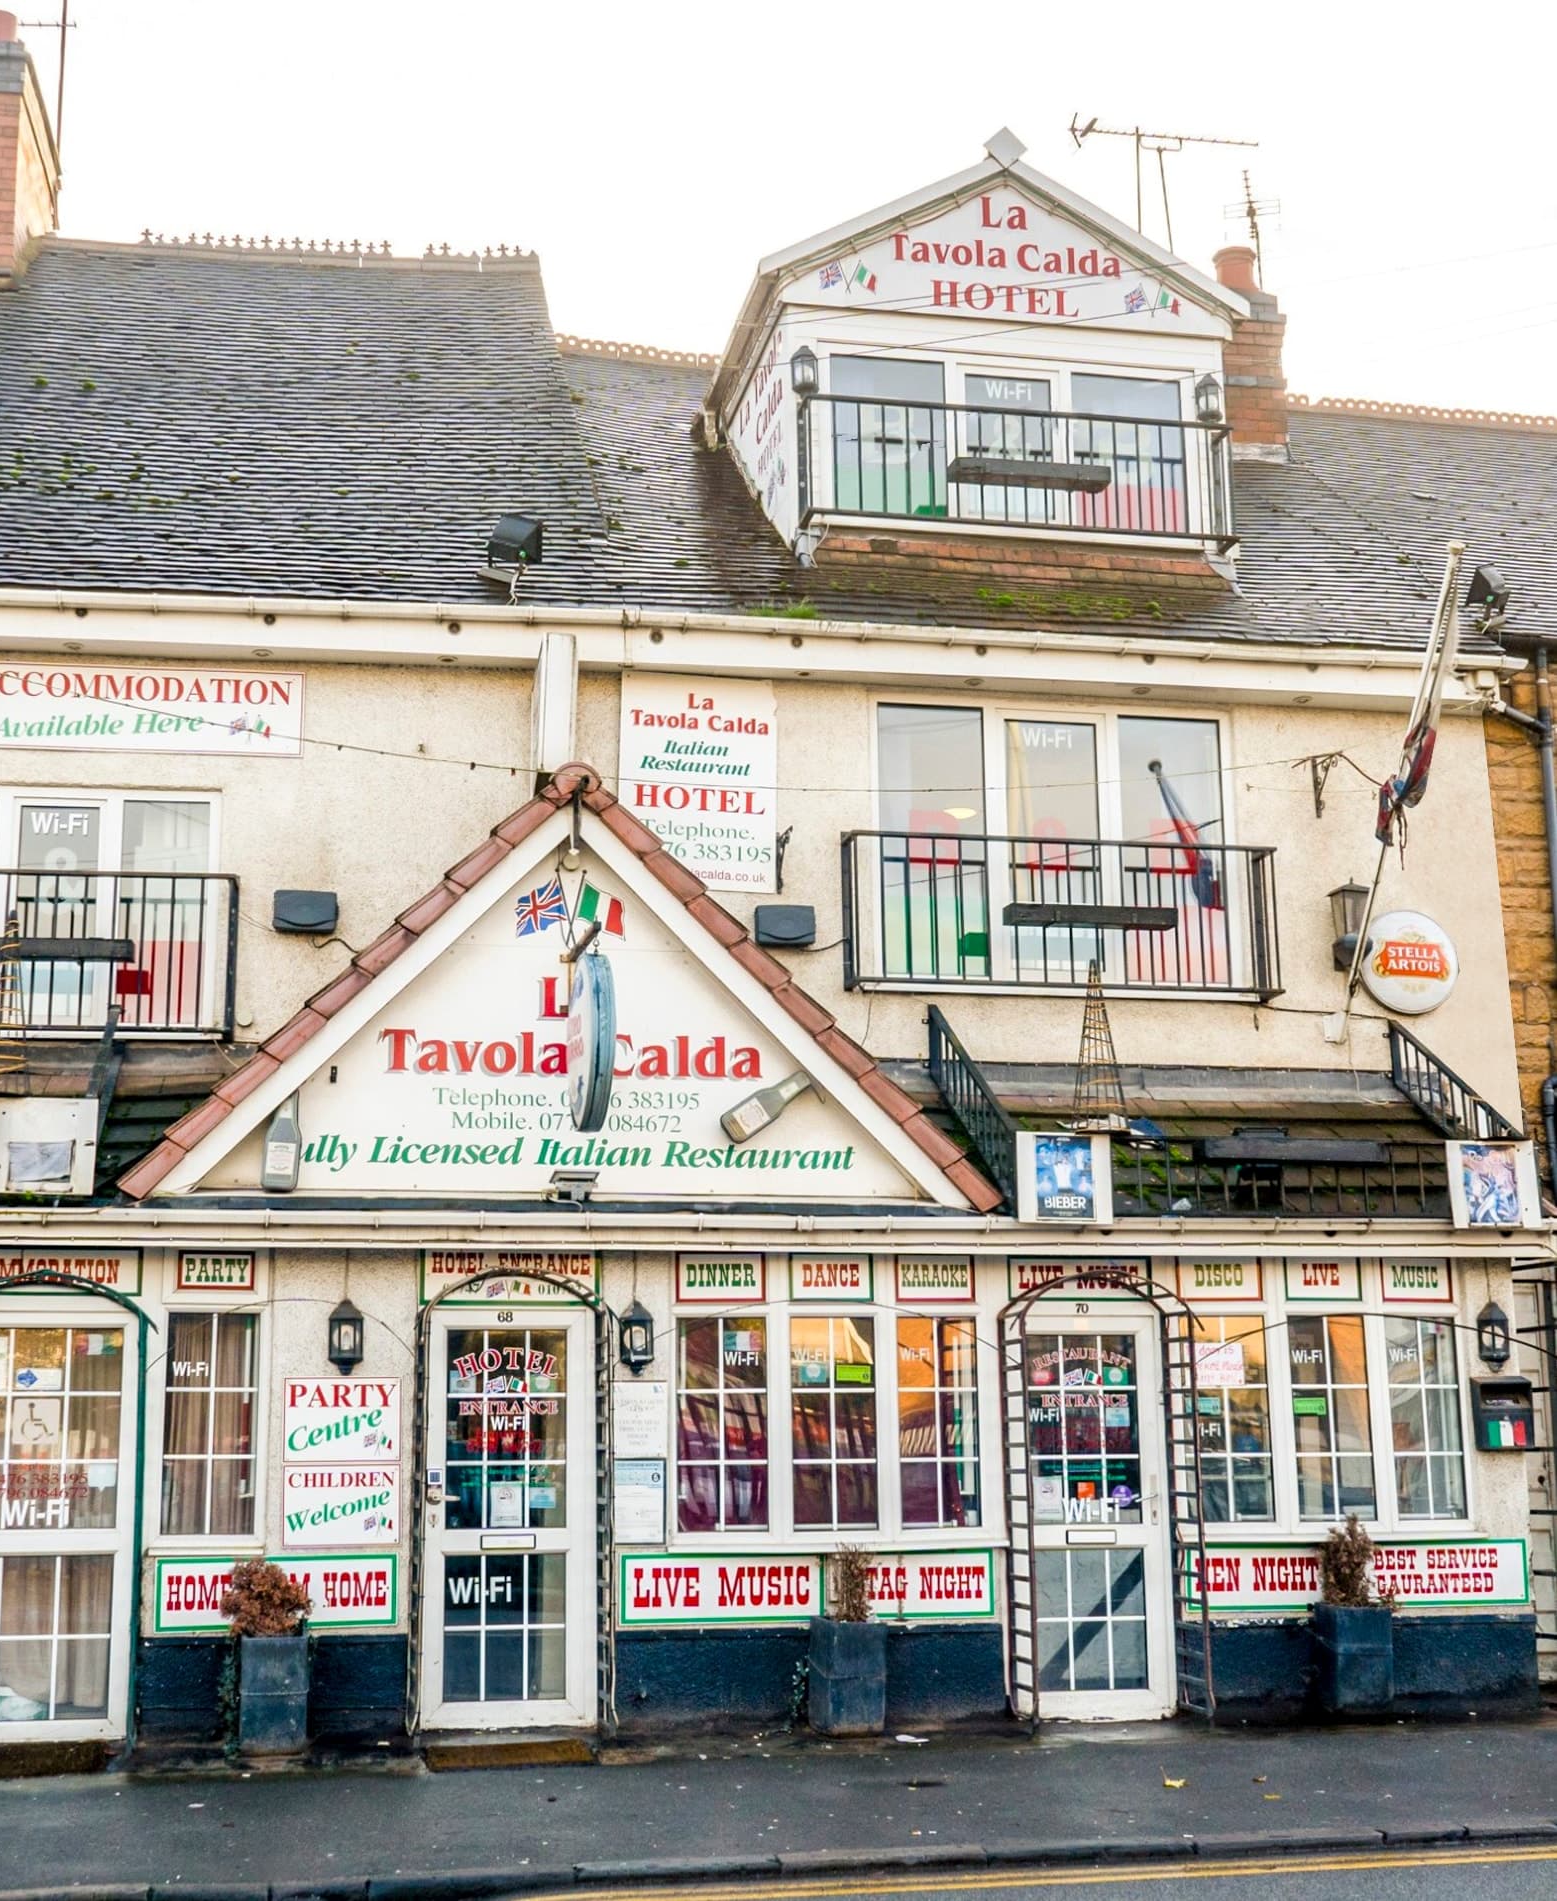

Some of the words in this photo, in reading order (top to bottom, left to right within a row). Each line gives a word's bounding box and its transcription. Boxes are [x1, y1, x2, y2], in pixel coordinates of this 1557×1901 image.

[980, 196, 1028, 230] La
[889, 232, 1007, 270] Tavola
[1015, 243, 1122, 278] Calda
[931, 279, 1080, 319] HOTEL
[985, 380, 1032, 402] Wi-Fi
[688, 693, 714, 710] La
[132, 713, 204, 735] Here
[630, 709, 699, 730] Tavola
[708, 715, 769, 735] Calda
[663, 740, 730, 757] Italian
[1021, 727, 1073, 749] Wi-Fi
[639, 754, 752, 777] Restaurant
[633, 783, 766, 816] HOTEL
[30, 811, 90, 836] Wi-Fi
[640, 818, 756, 841] Telephone.
[693, 843, 772, 864] 383195
[1387, 945, 1439, 961] STELLA
[1387, 958, 1441, 973] ARTOIS
[539, 976, 569, 1019] L
[381, 1028, 568, 1078] Tavola
[612, 1034, 763, 1080] Calda
[432, 1086, 553, 1112] Telephone.
[627, 1090, 701, 1111] 383195
[451, 1111, 532, 1132] Mobile.
[607, 1114, 682, 1134] 084672
[300, 1134, 357, 1172] ully
[369, 1135, 524, 1167] Licensed
[533, 1137, 652, 1168] Italian
[661, 1141, 857, 1172] Restaurant
[1044, 1196, 1087, 1209] BIEBER
[185, 1257, 249, 1283] PARTY
[431, 1252, 489, 1274] HOTEL
[1302, 1263, 1340, 1286] LIVE
[686, 1264, 756, 1287] DINNER
[802, 1264, 860, 1287] DANCE
[901, 1264, 968, 1288] KARAOKE
[1018, 1265, 1064, 1289] LIVE
[1194, 1263, 1244, 1287] DISCO
[1391, 1265, 1439, 1288] MUSIC
[497, 1312, 514, 1323] 68
[1075, 1303, 1089, 1314] 70
[453, 1347, 559, 1380] HOTEL
[724, 1351, 759, 1366] Wi-Fi
[900, 1347, 931, 1361] Wi-Fi
[1291, 1349, 1323, 1364] Wi-Fi
[1388, 1348, 1417, 1362] Wi-Fi
[172, 1361, 209, 1378] Wi-Fi
[288, 1384, 396, 1408] PARTY
[1040, 1394, 1129, 1408] ENTRANCE
[458, 1400, 559, 1416] ENTRANCE
[1029, 1407, 1059, 1422] Wi-Fi
[287, 1408, 383, 1452] Centre
[490, 1416, 526, 1431] Wi-Fi
[288, 1471, 395, 1488] CHILDREN
[1, 1499, 71, 1527] Wi-Fi
[285, 1490, 391, 1533] Welcome
[1062, 1496, 1120, 1524] Wi-Fi
[1373, 1550, 1416, 1571] BEST
[1426, 1547, 1499, 1570] SERVICE
[866, 1567, 909, 1600] TAG
[920, 1566, 986, 1600] NIGHT
[1252, 1556, 1319, 1593] NIGHT
[1377, 1572, 1495, 1595] GAURANTEED
[323, 1571, 387, 1608] HOME
[448, 1575, 512, 1605] Wi-Fi
[633, 1567, 700, 1608] LIVE
[718, 1565, 811, 1607] MUSIC
